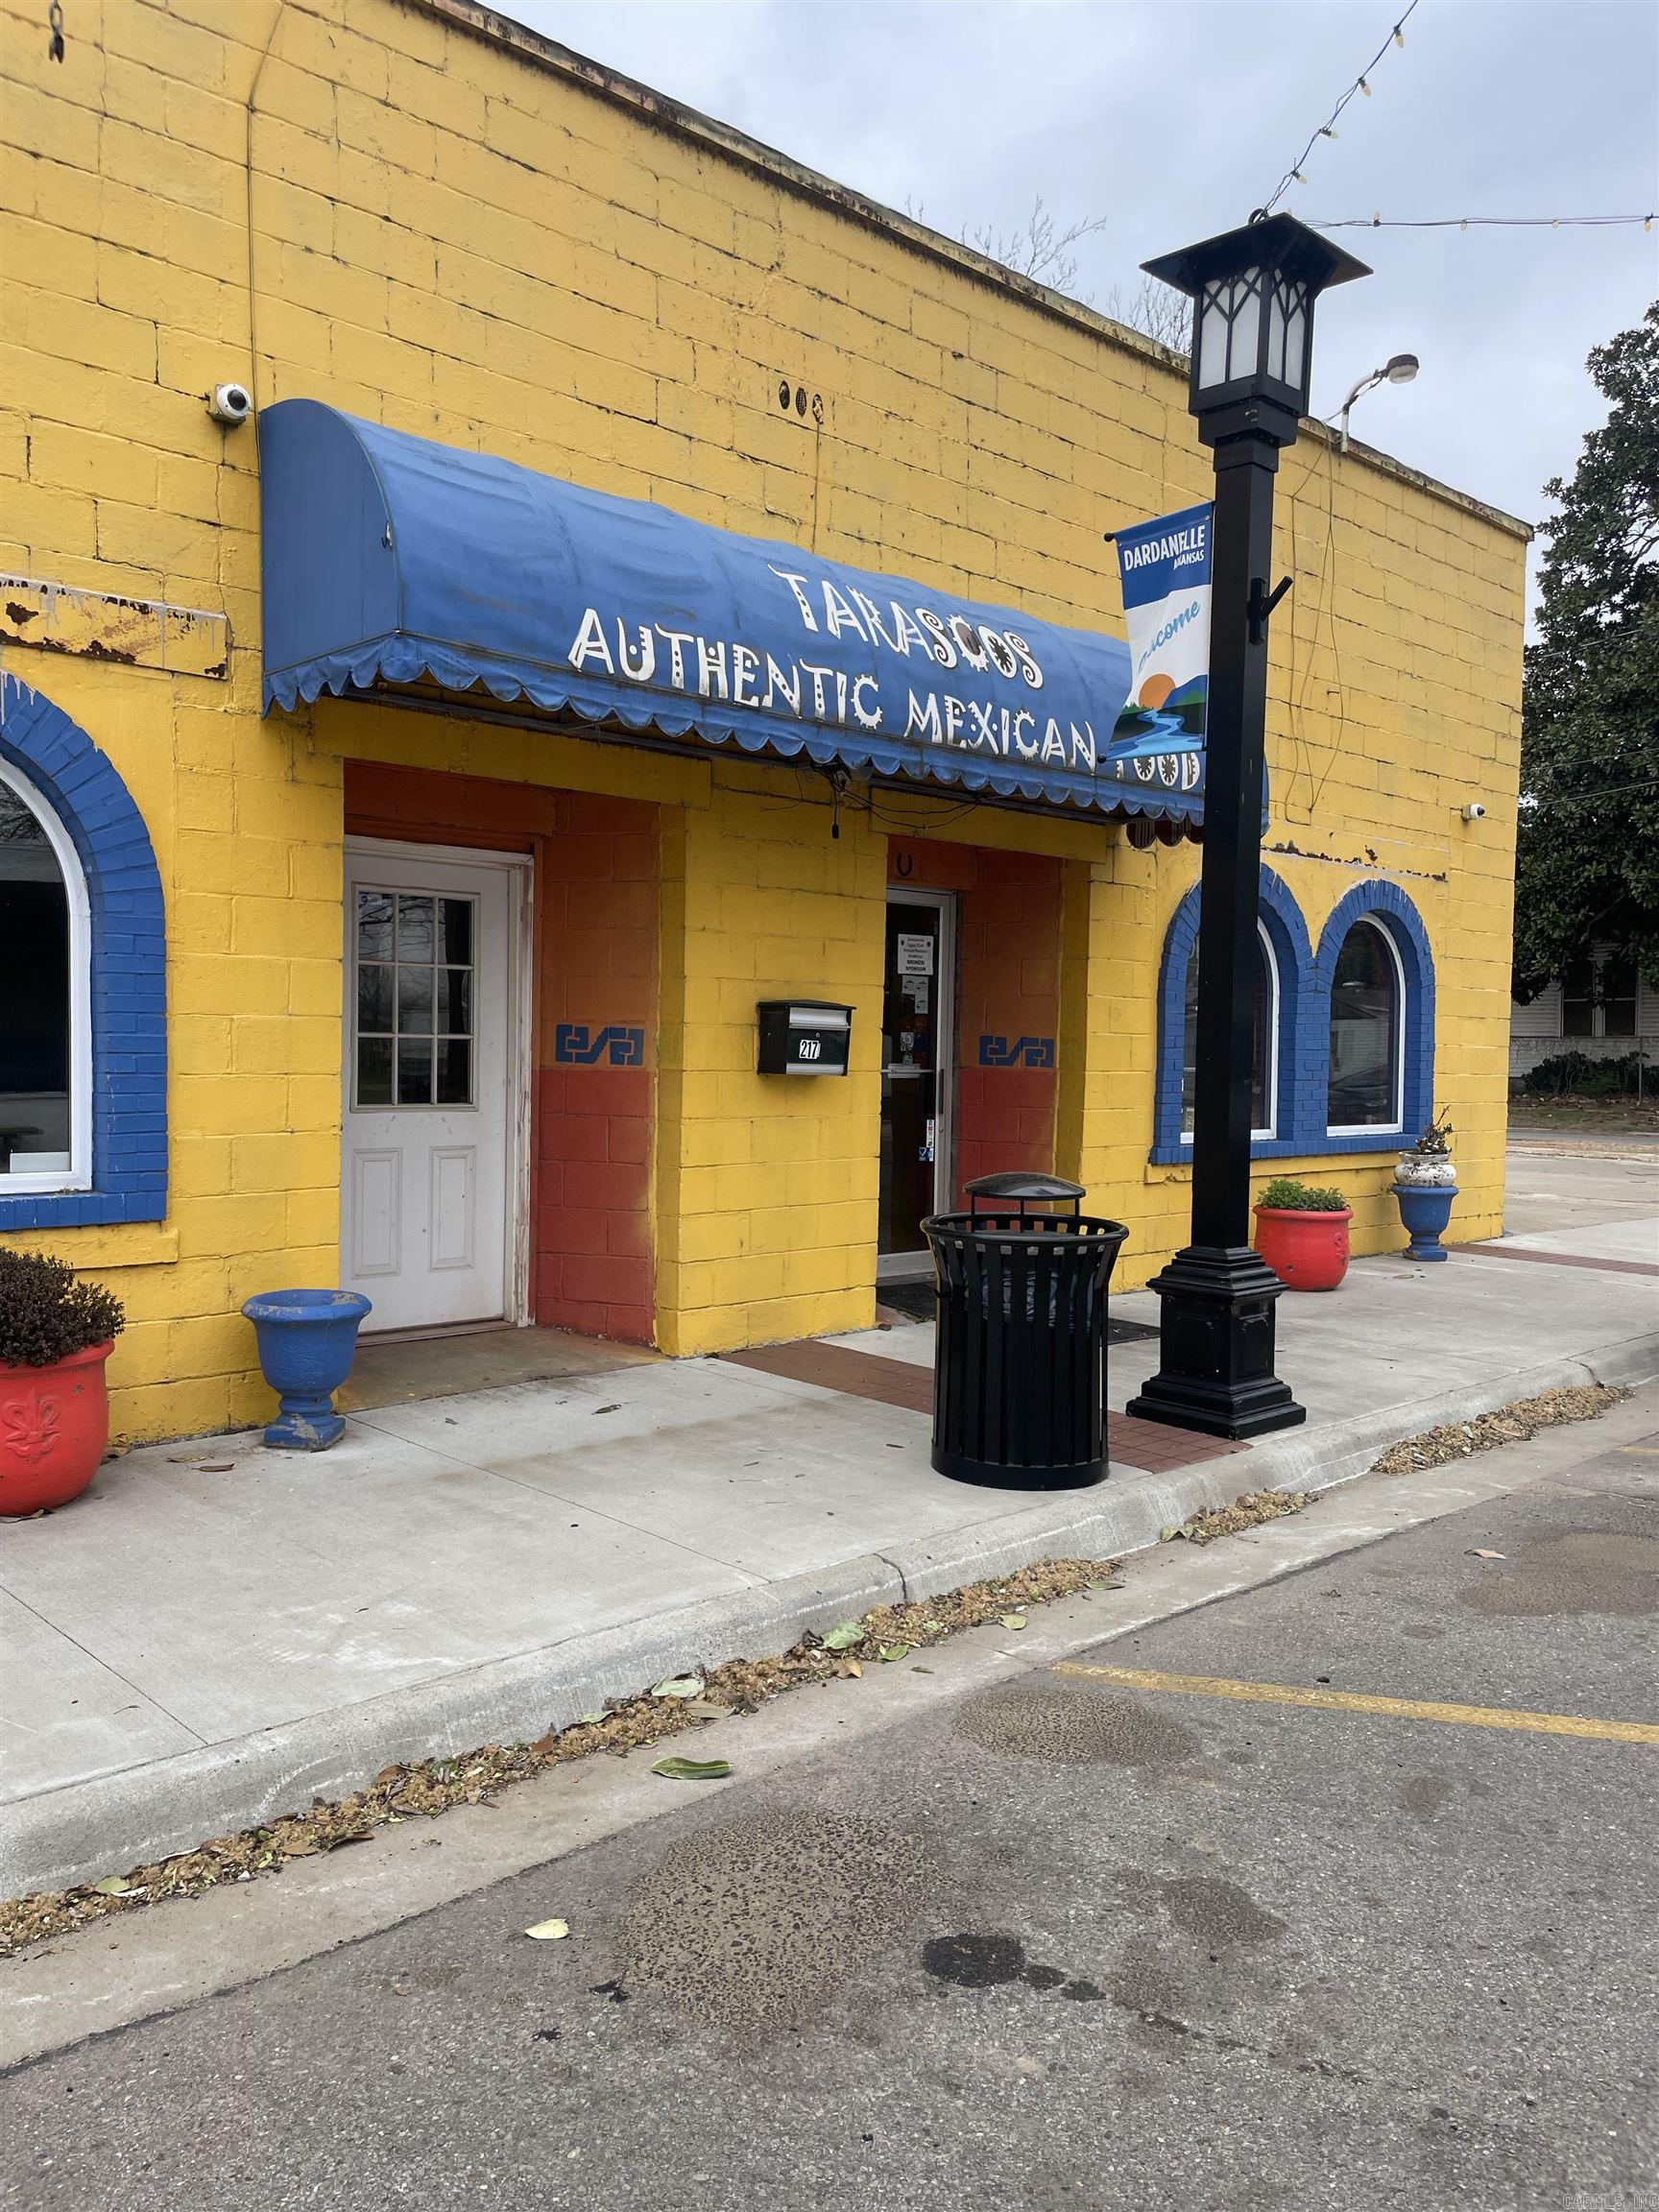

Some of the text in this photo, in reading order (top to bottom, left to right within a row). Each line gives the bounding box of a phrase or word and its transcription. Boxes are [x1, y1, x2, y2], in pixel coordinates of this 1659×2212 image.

[1123, 524, 1206, 571] DARDANELLE
[767, 563, 1045, 689] TARASCOS
[1138, 600, 1201, 674] come
[567, 608, 1201, 791] AUTHENTIC MEXICAN OOD
[800, 1040, 819, 1058] 217
